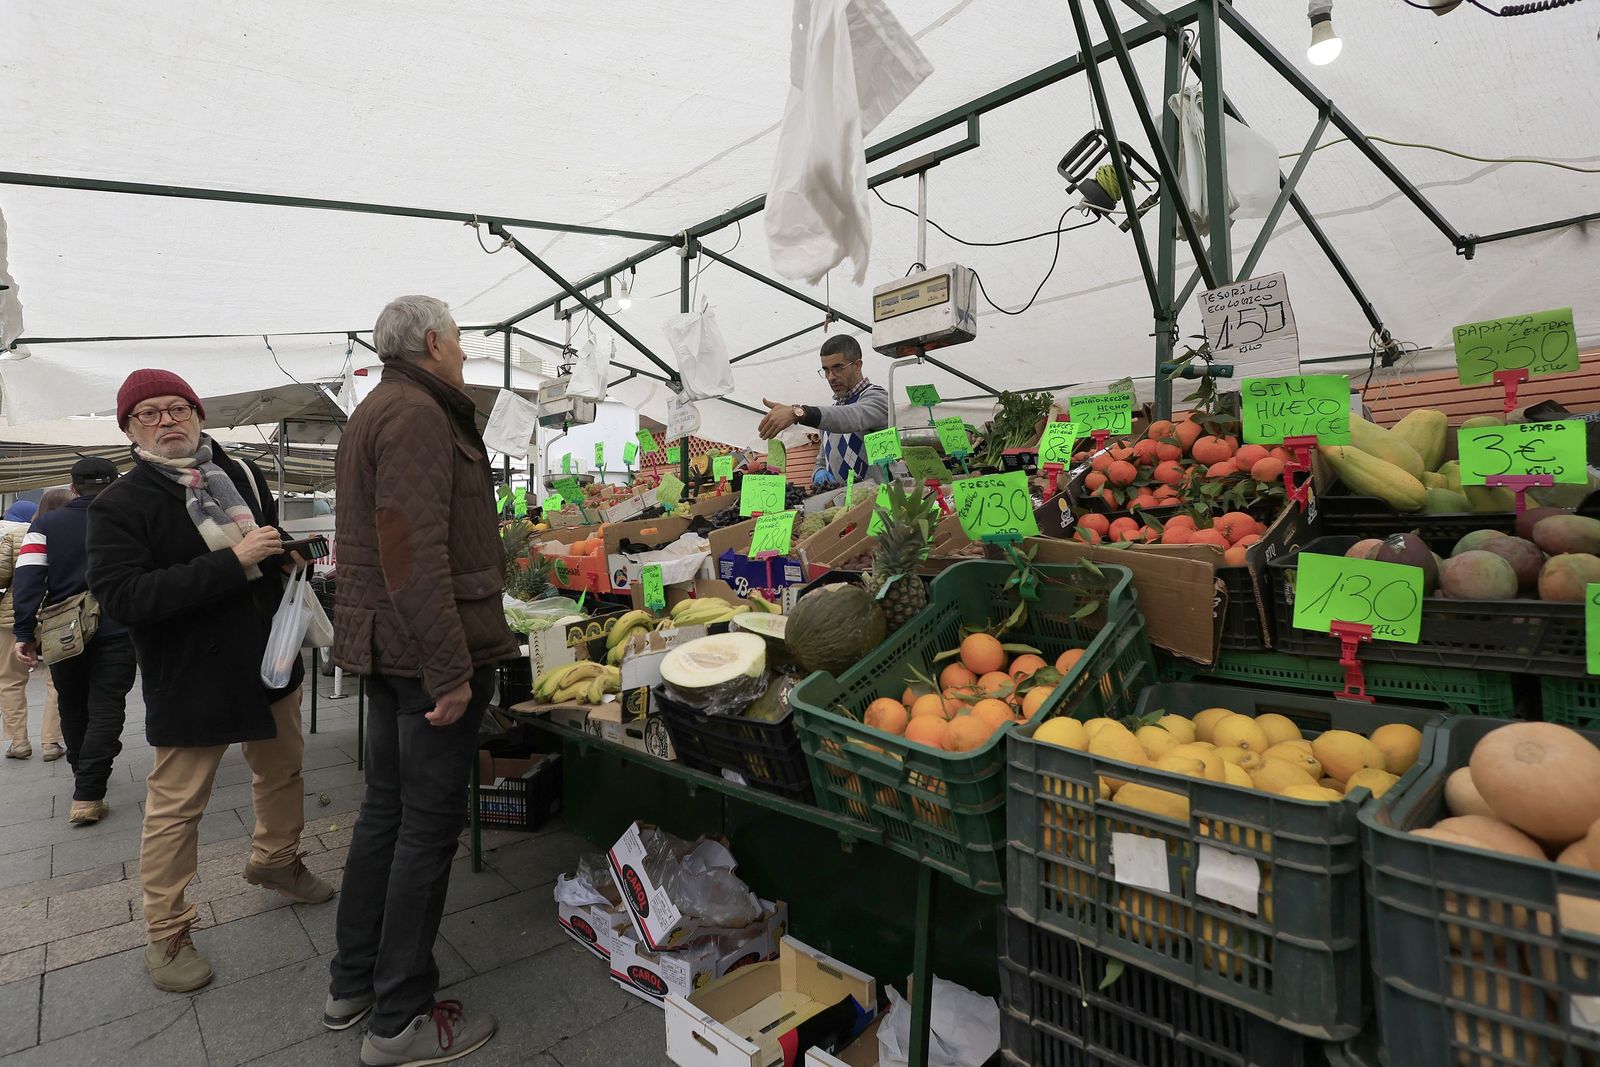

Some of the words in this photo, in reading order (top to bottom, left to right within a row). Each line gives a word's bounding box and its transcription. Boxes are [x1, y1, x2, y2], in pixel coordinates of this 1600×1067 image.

[1201, 280, 1278, 305] TESORILLO
[1215, 300, 1286, 350] 1'50
[1456, 316, 1534, 343] PAPAYA
[1464, 330, 1570, 378] 3'50
[1249, 378, 1306, 397] SIN
[1256, 397, 1341, 419] HUESO
[959, 479, 1006, 491] FRESCA
[968, 488, 1028, 531] 1'30
[1300, 571, 1418, 623] 1'30
[625, 869, 648, 912] CAROL
[631, 967, 663, 991] CAROL
